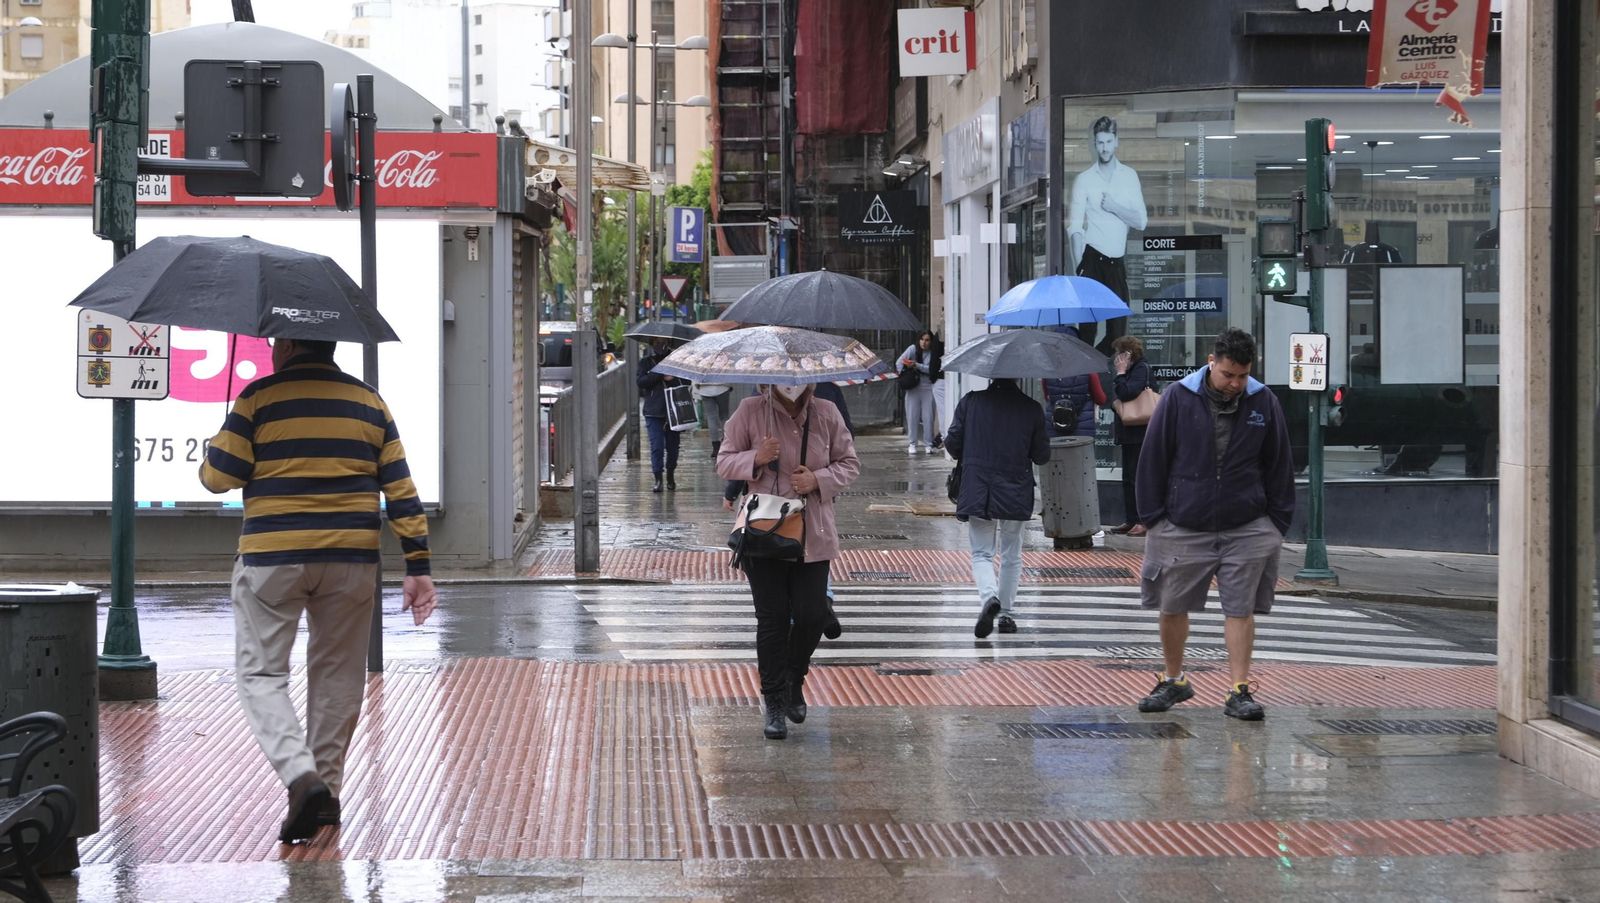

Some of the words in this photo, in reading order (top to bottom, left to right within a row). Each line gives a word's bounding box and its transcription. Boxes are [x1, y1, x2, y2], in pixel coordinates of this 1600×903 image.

[904, 29, 960, 55] crit
[1398, 32, 1458, 47] Almería
[1397, 44, 1456, 57] centro
[1415, 62, 1436, 71] LUIS
[1400, 70, 1449, 80] GÁZQUEZ
[138, 184, 150, 196] 54
[154, 184, 167, 196] 04
[680, 208, 696, 242] P
[1144, 238, 1176, 249] CORTE
[1144, 299, 1175, 311] DISEÑO
[1177, 301, 1187, 310] DE
[1189, 301, 1217, 310] BARBA
[271, 306, 340, 319] PROFILTER
